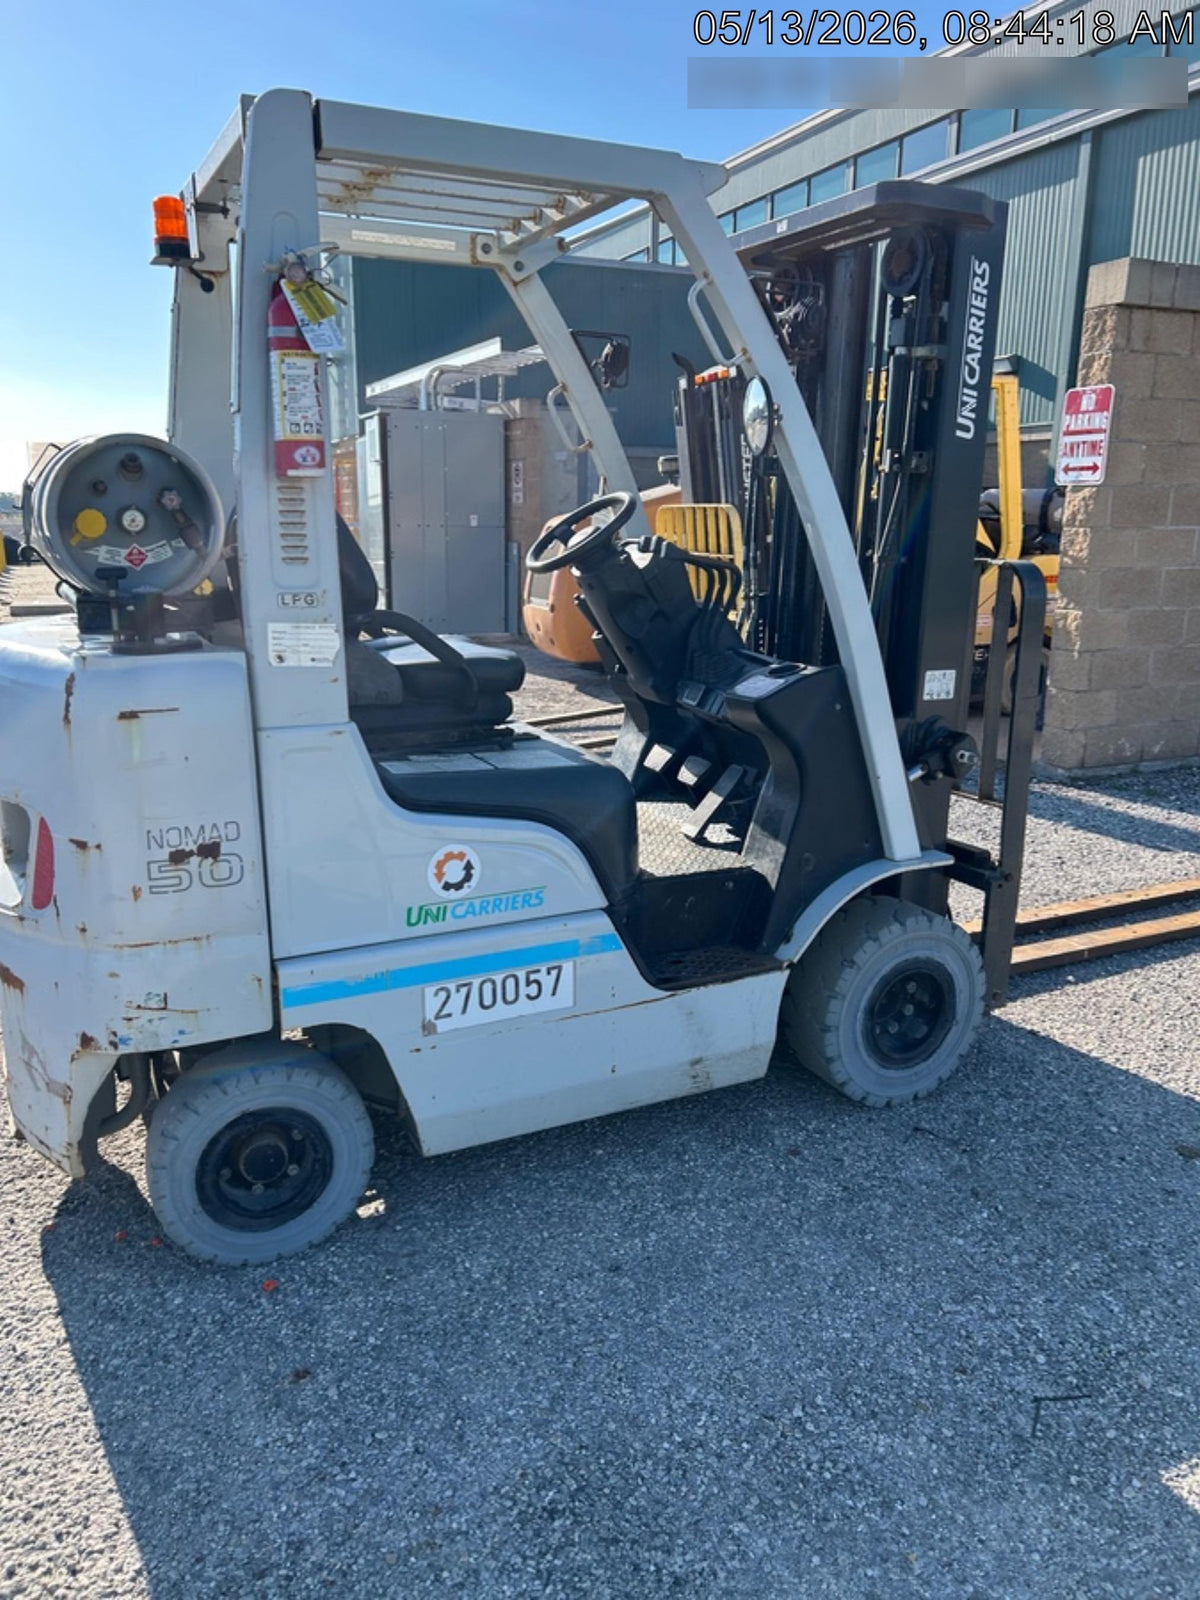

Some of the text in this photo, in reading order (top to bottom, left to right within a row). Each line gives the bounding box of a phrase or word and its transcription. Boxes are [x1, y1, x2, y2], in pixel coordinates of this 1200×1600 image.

[1080, 392, 1097, 412] NO
[1063, 410, 1108, 431] PARKING
[1061, 440, 1104, 458] ANYTIME
[281, 593, 315, 606] LPG
[146, 820, 241, 850] NOMAD
[146, 852, 244, 895] 50
[433, 964, 563, 1021] 270057
